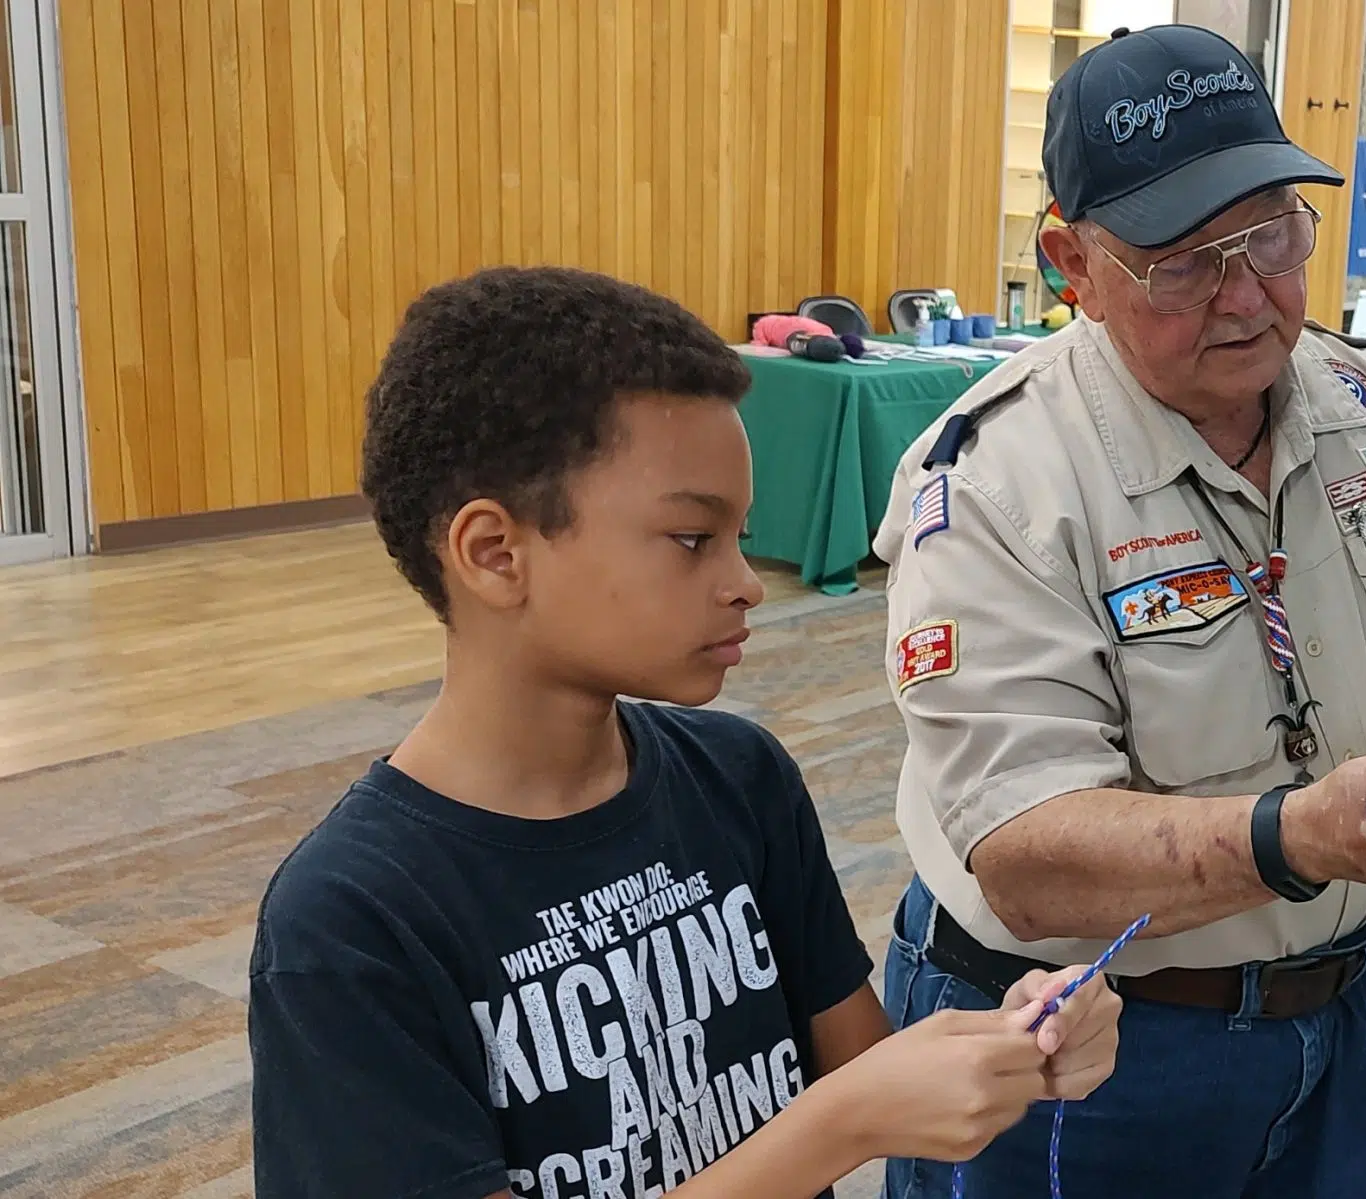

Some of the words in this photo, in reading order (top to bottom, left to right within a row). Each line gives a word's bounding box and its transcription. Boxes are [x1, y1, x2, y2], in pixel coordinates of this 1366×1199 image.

[1167, 59, 1254, 109] Scouts
[1108, 545, 1131, 562] BOY
[1165, 529, 1203, 547] AMERICA
[913, 658, 935, 675] 2017
[501, 928, 581, 983] WHERE
[579, 912, 617, 956] WE
[618, 870, 714, 935] ENCOURAGE
[535, 904, 582, 938] TAE
[579, 875, 655, 923] KWON
[644, 861, 676, 897] DO:
[470, 883, 779, 1110] KICKING
[607, 1018, 708, 1151] AND
